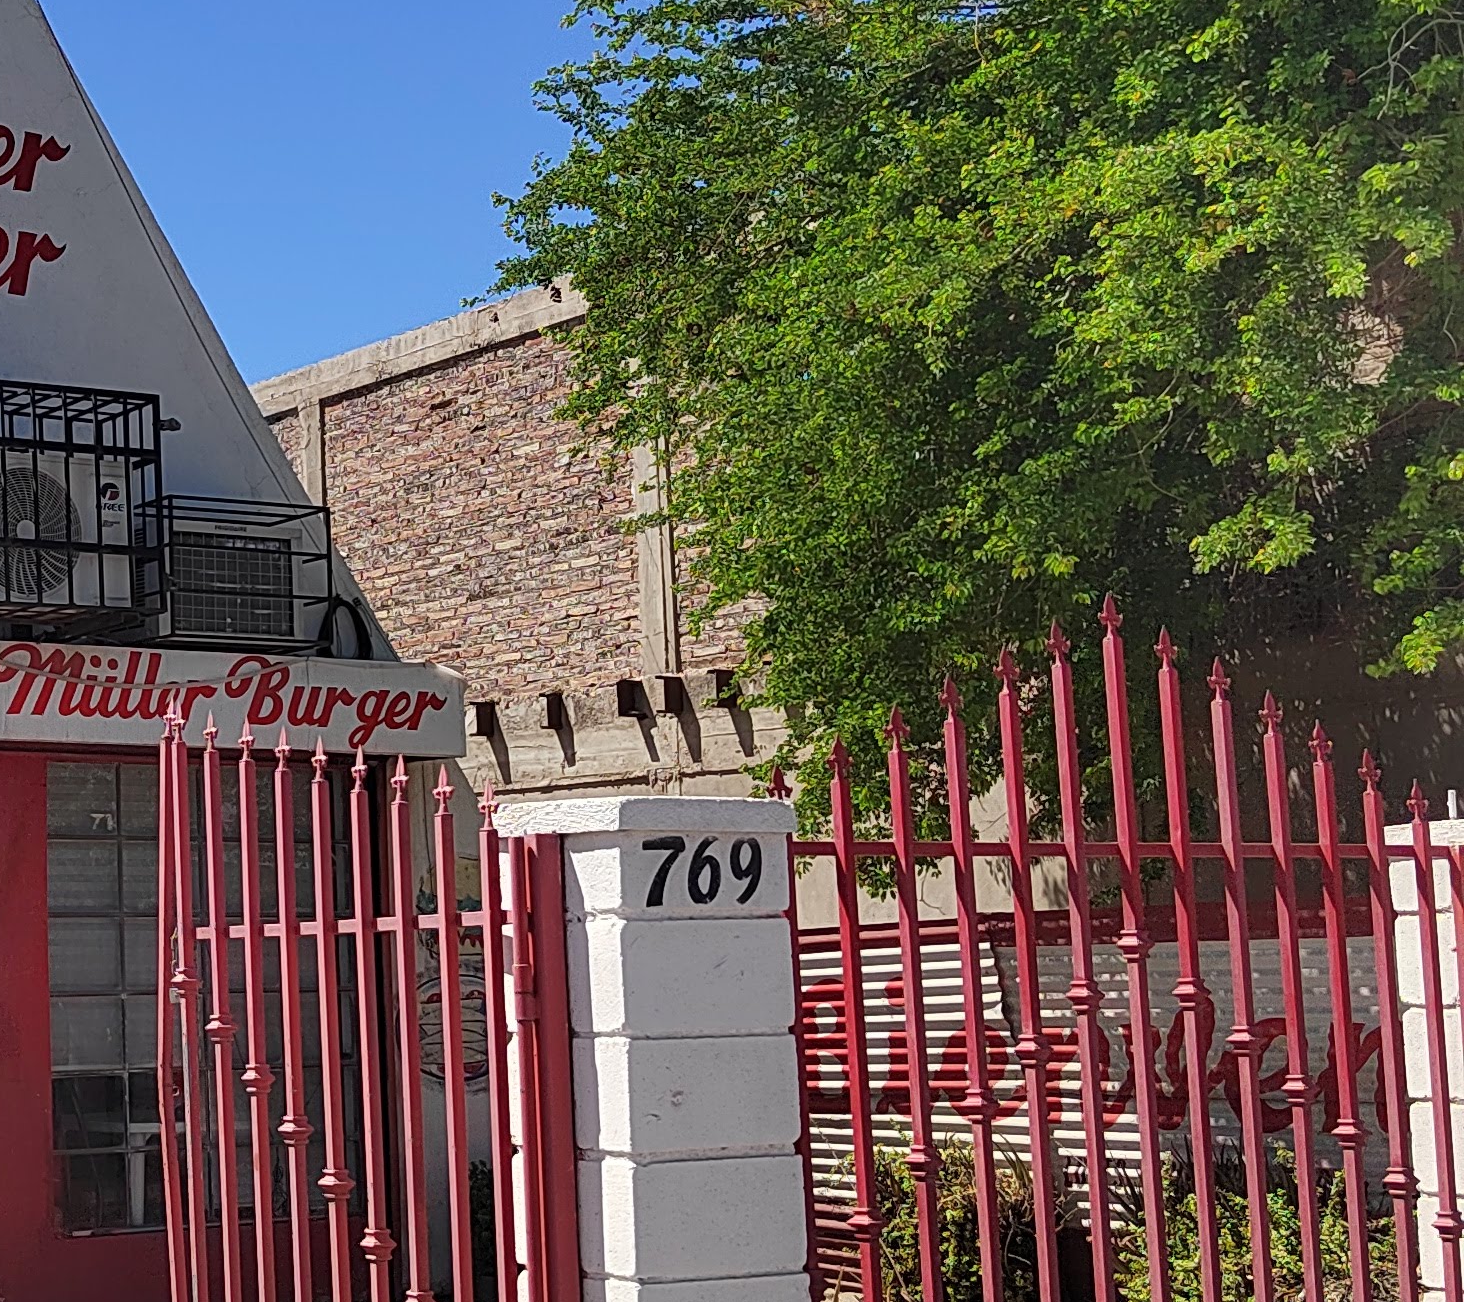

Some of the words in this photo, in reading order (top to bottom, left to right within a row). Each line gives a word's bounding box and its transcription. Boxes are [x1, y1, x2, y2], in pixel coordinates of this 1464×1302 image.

[95, 502, 125, 512] REE
[225, 655, 447, 751] Burger
[641, 835, 762, 908] 769
